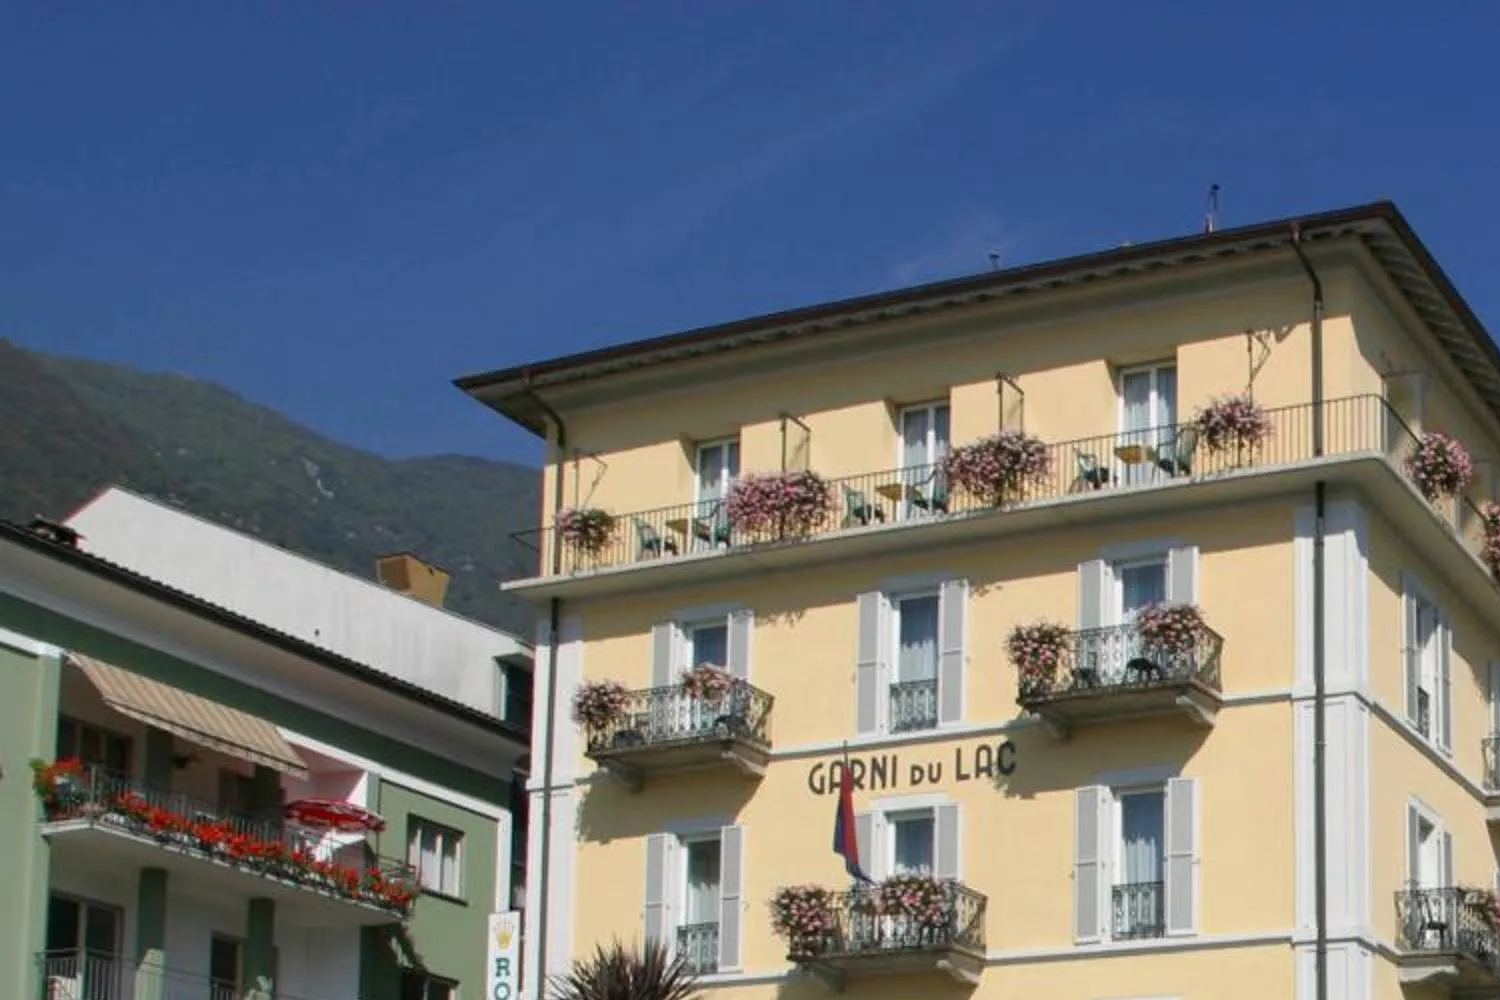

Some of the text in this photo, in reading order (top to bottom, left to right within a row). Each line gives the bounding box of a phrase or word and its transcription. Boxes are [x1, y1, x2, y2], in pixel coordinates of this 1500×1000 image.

[808, 741, 1017, 794] GARNI DU LAC
